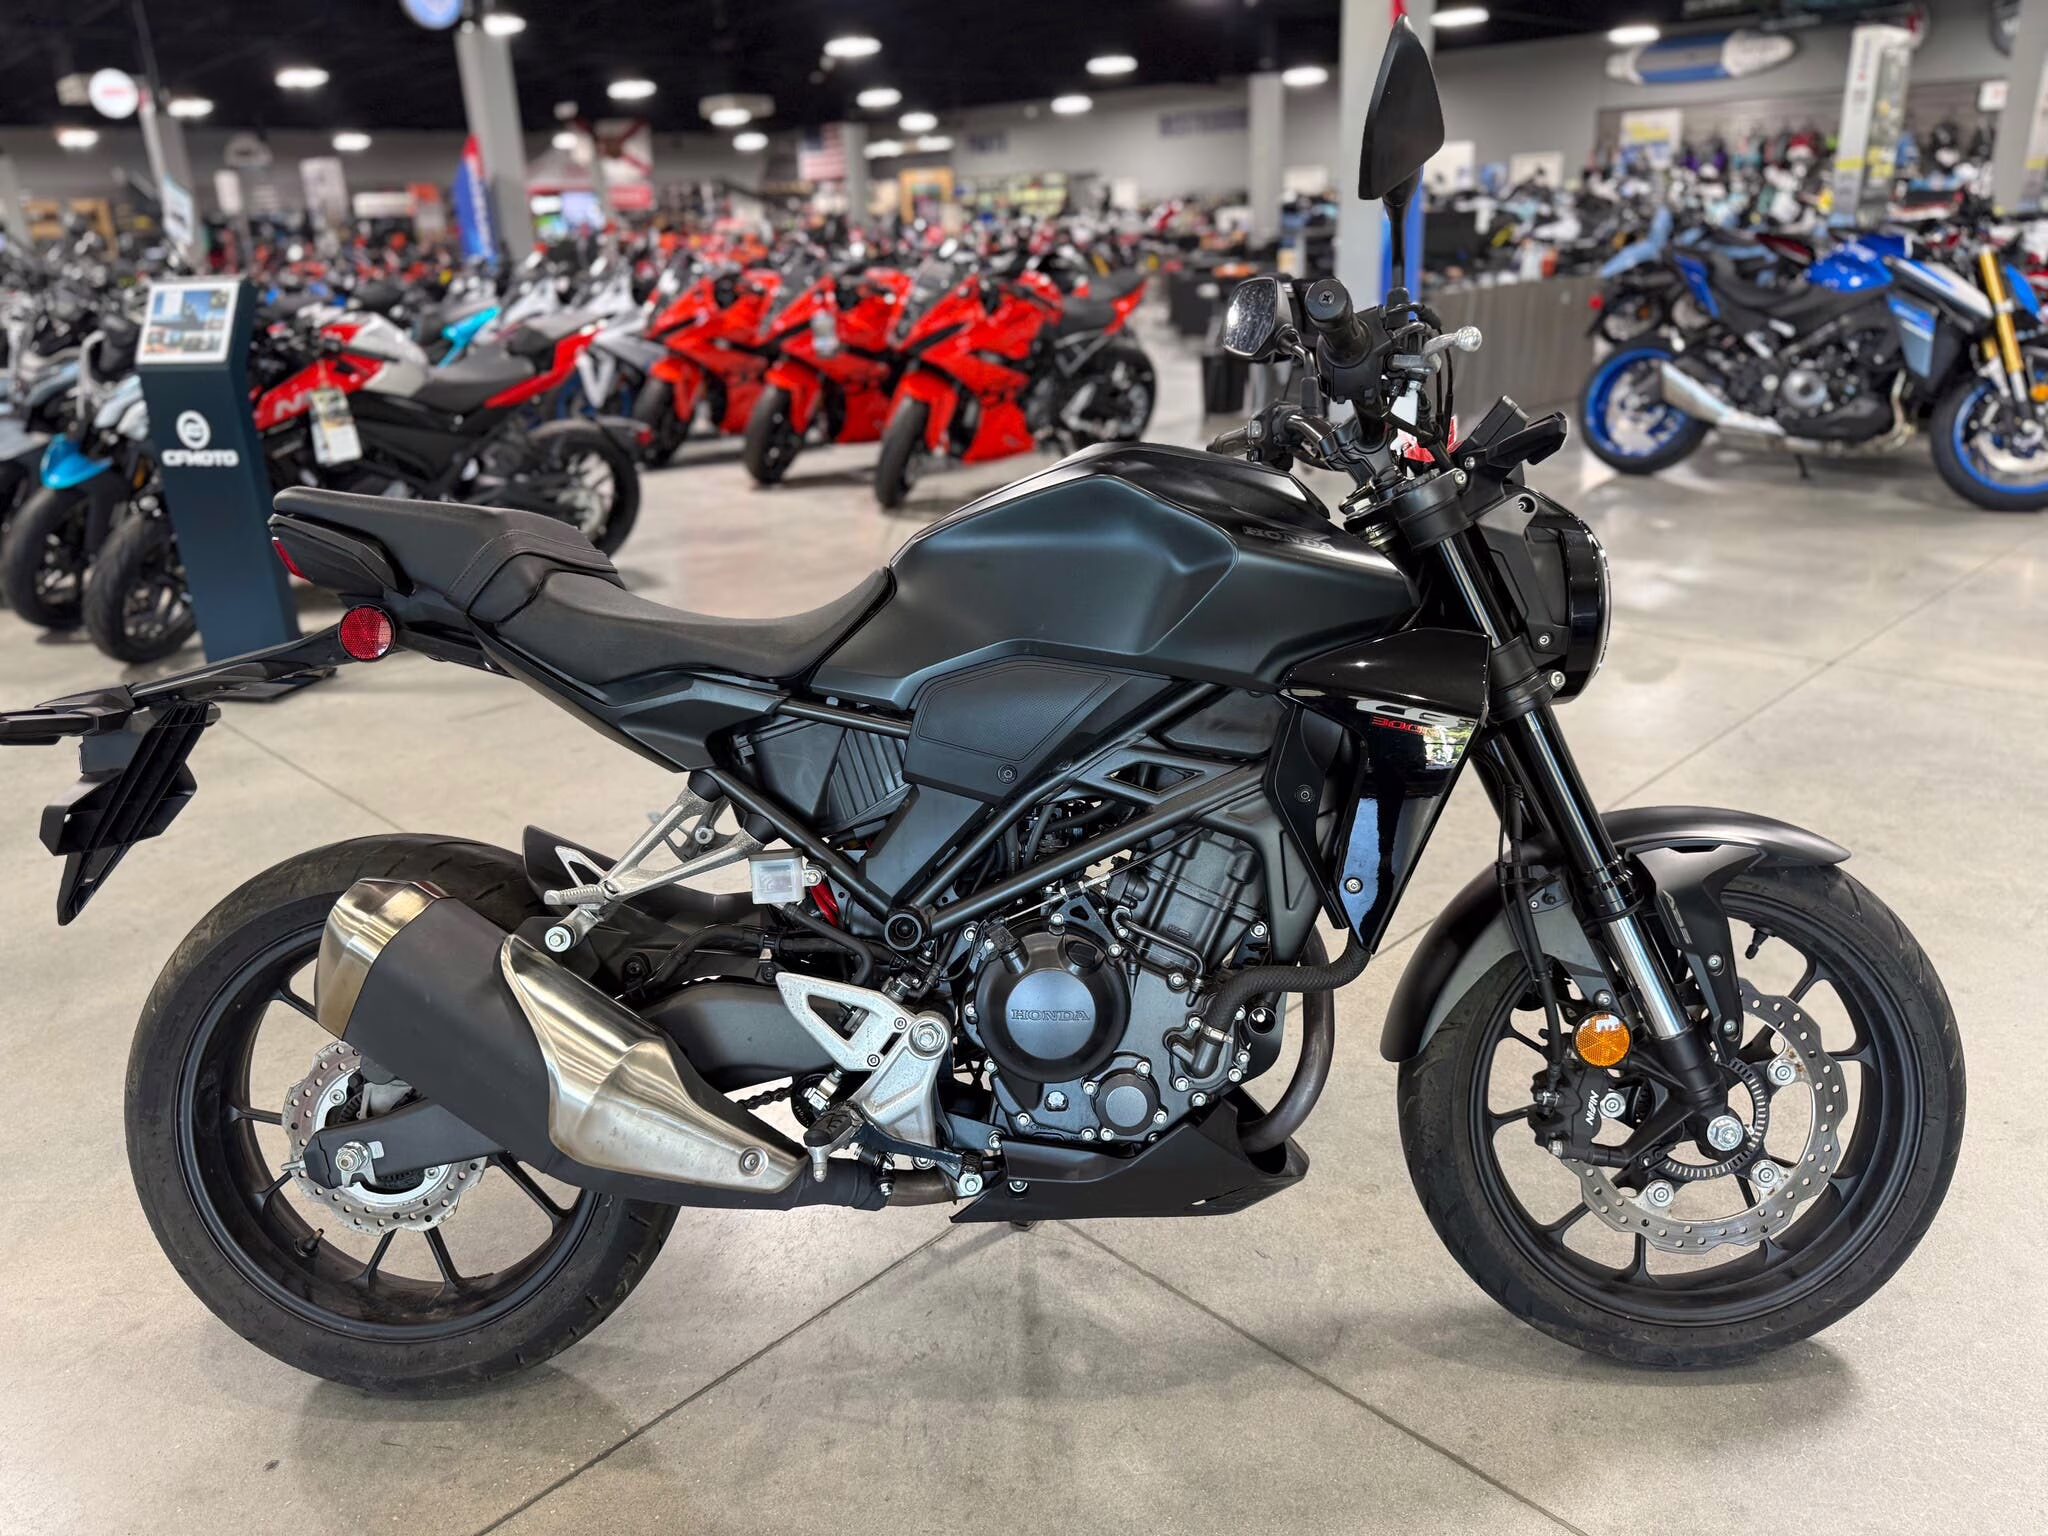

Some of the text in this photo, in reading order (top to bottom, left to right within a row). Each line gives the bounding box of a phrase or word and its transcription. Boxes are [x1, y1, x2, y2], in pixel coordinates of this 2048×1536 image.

[161, 449, 239, 467] CFMOTO
[1241, 526, 1337, 552] HONDA
[1356, 699, 1460, 728] CB
[1011, 1009, 1090, 1021] HONDA
